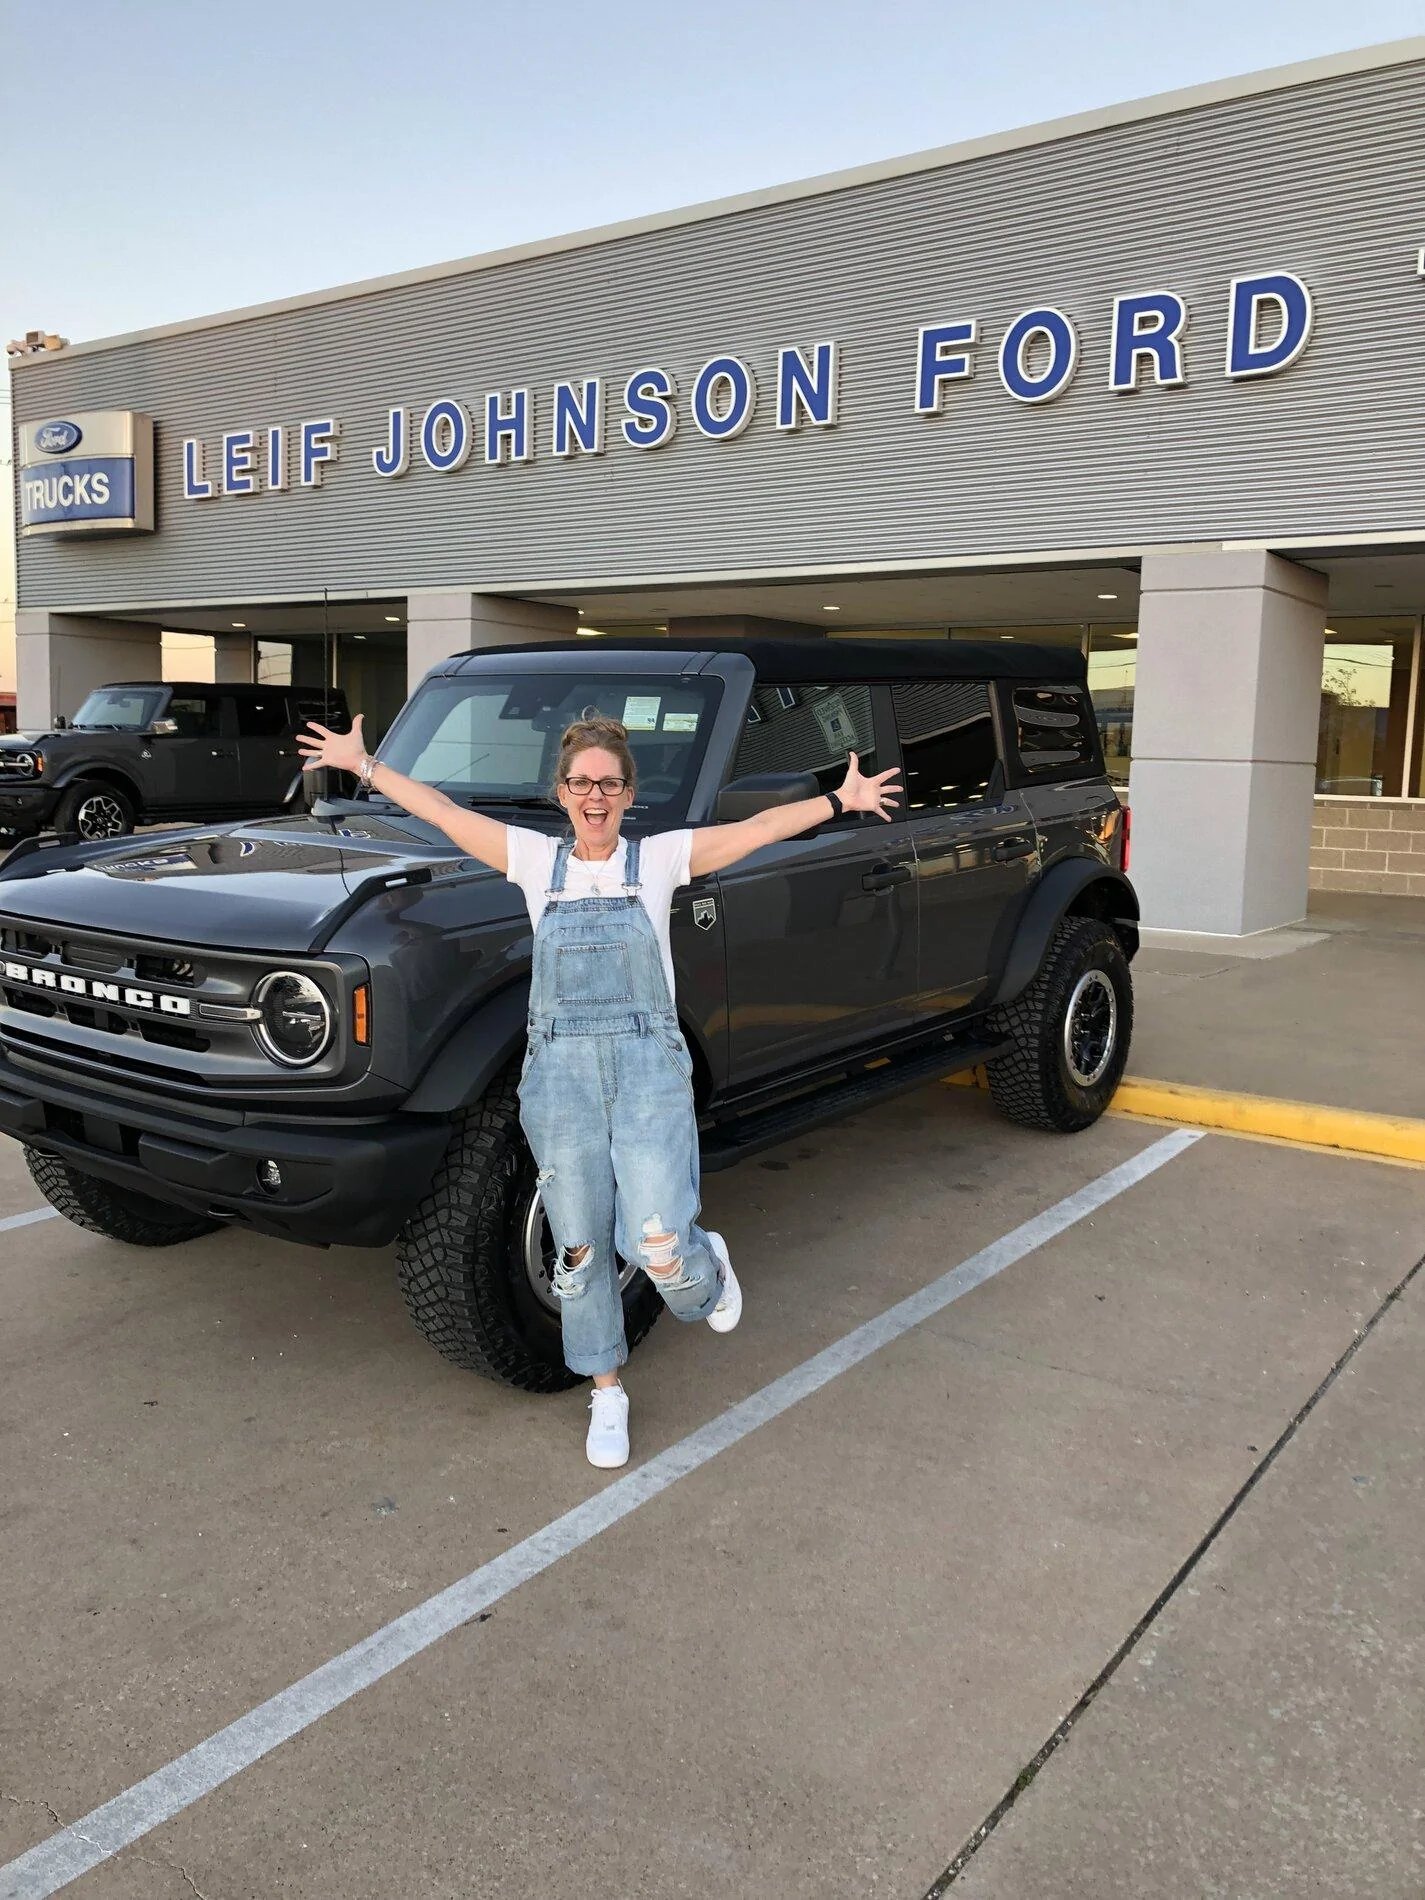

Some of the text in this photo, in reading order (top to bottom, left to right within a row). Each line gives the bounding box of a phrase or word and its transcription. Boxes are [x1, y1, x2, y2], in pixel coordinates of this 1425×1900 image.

[182, 270, 1314, 500] LEIF JOHNSON FORD
[40, 426, 69, 448] Ford
[24, 472, 111, 512] TRUCKS
[5, 961, 191, 1015] BRONCO
